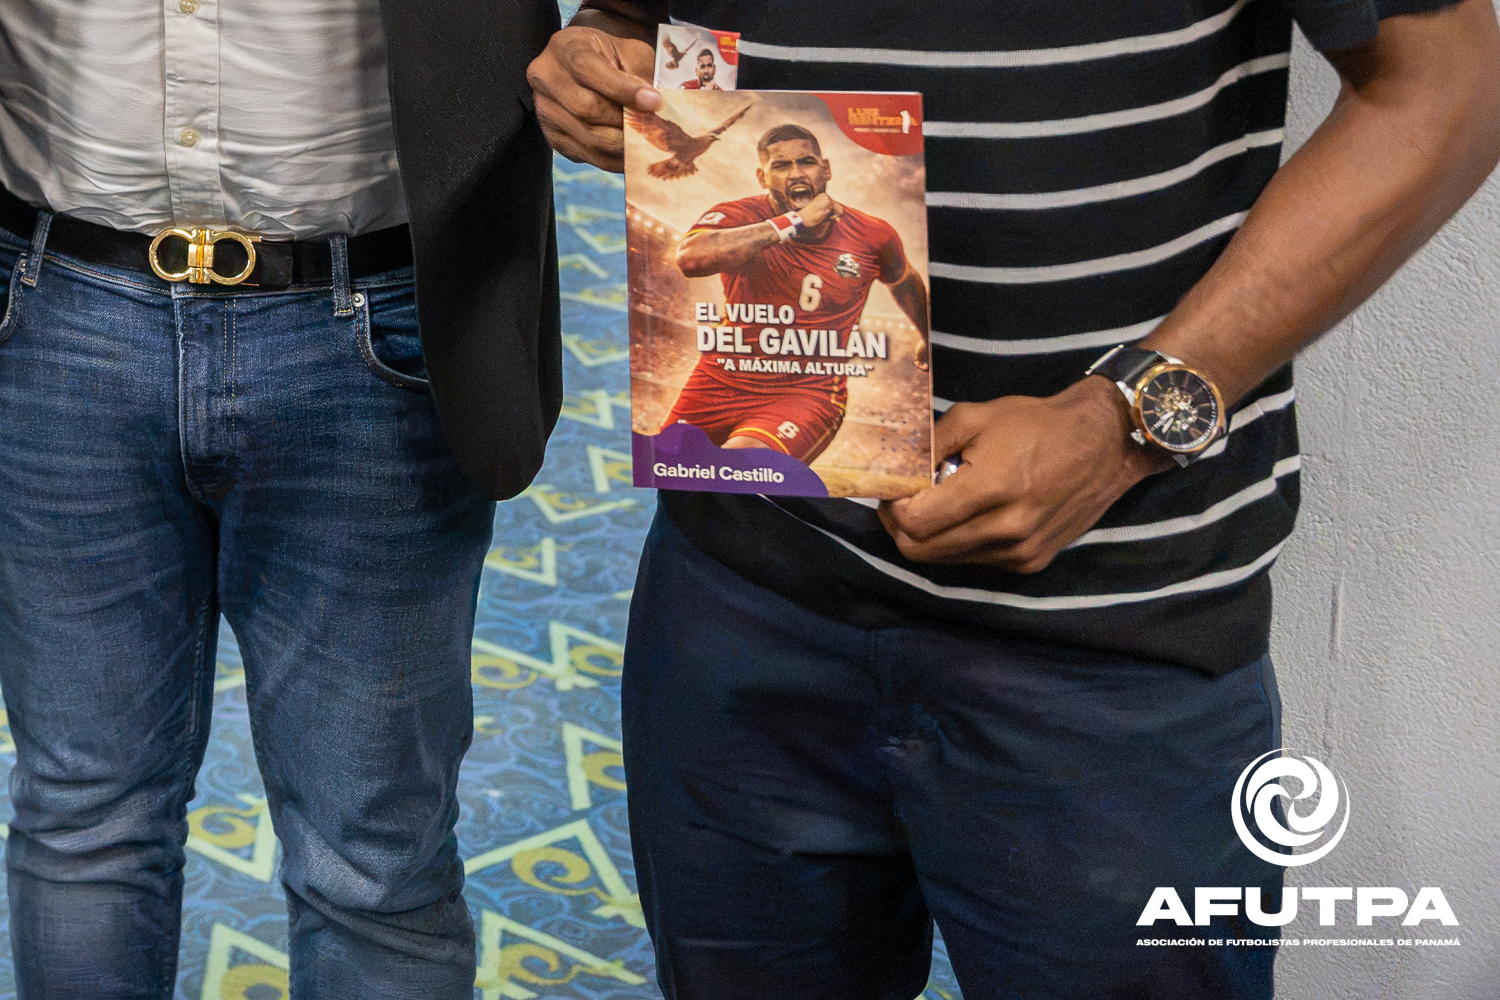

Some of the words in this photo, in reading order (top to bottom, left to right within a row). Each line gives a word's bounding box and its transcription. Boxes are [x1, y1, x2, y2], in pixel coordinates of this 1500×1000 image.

[799, 273, 823, 312] 6
[695, 302, 720, 321] EL
[725, 303, 795, 325] VUELO
[697, 325, 752, 353] DEL
[759, 325, 887, 359] GAVILÁN
[739, 358, 802, 373] MÁXIMA
[804, 362, 874, 376] ALTURA"
[653, 463, 715, 479] Gabriel
[719, 466, 785, 483] Castillo
